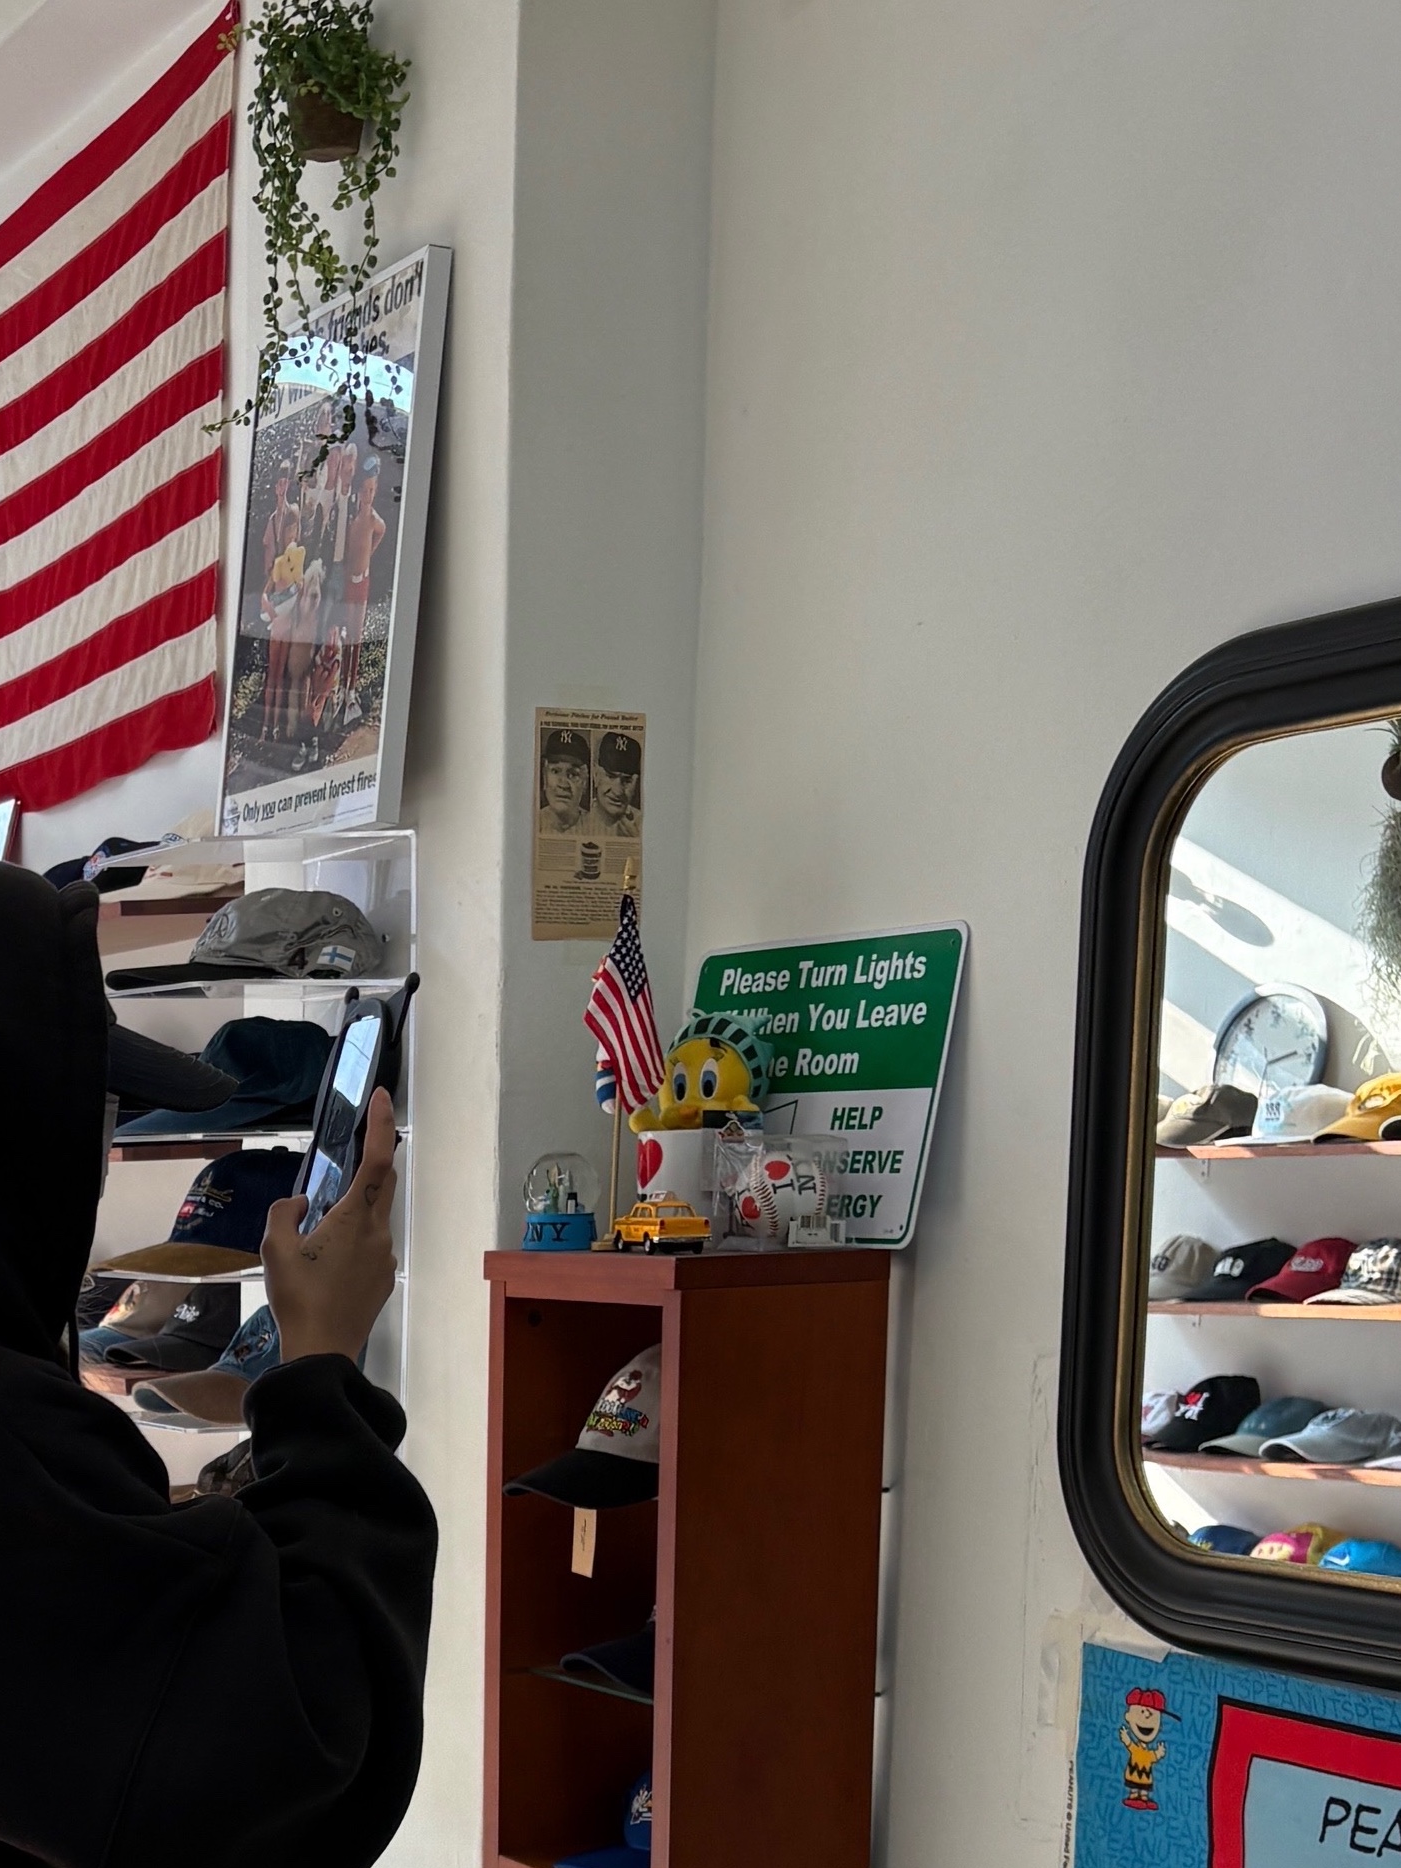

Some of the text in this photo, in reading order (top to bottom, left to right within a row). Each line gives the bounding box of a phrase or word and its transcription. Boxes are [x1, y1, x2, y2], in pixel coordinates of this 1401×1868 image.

[243, 802, 261, 823] Only
[261, 800, 275, 820] you
[278, 796, 292, 813] can
[294, 783, 327, 812] prevent
[329, 779, 355, 800] forest
[719, 951, 927, 996] Please Turn Lights
[808, 1003, 850, 1032] You
[855, 999, 927, 1029] Leave
[793, 1048, 859, 1077] Room
[830, 1106, 884, 1131] HELP
[812, 1150, 904, 1174] ONSERVE
[826, 1194, 882, 1219] ERGY
